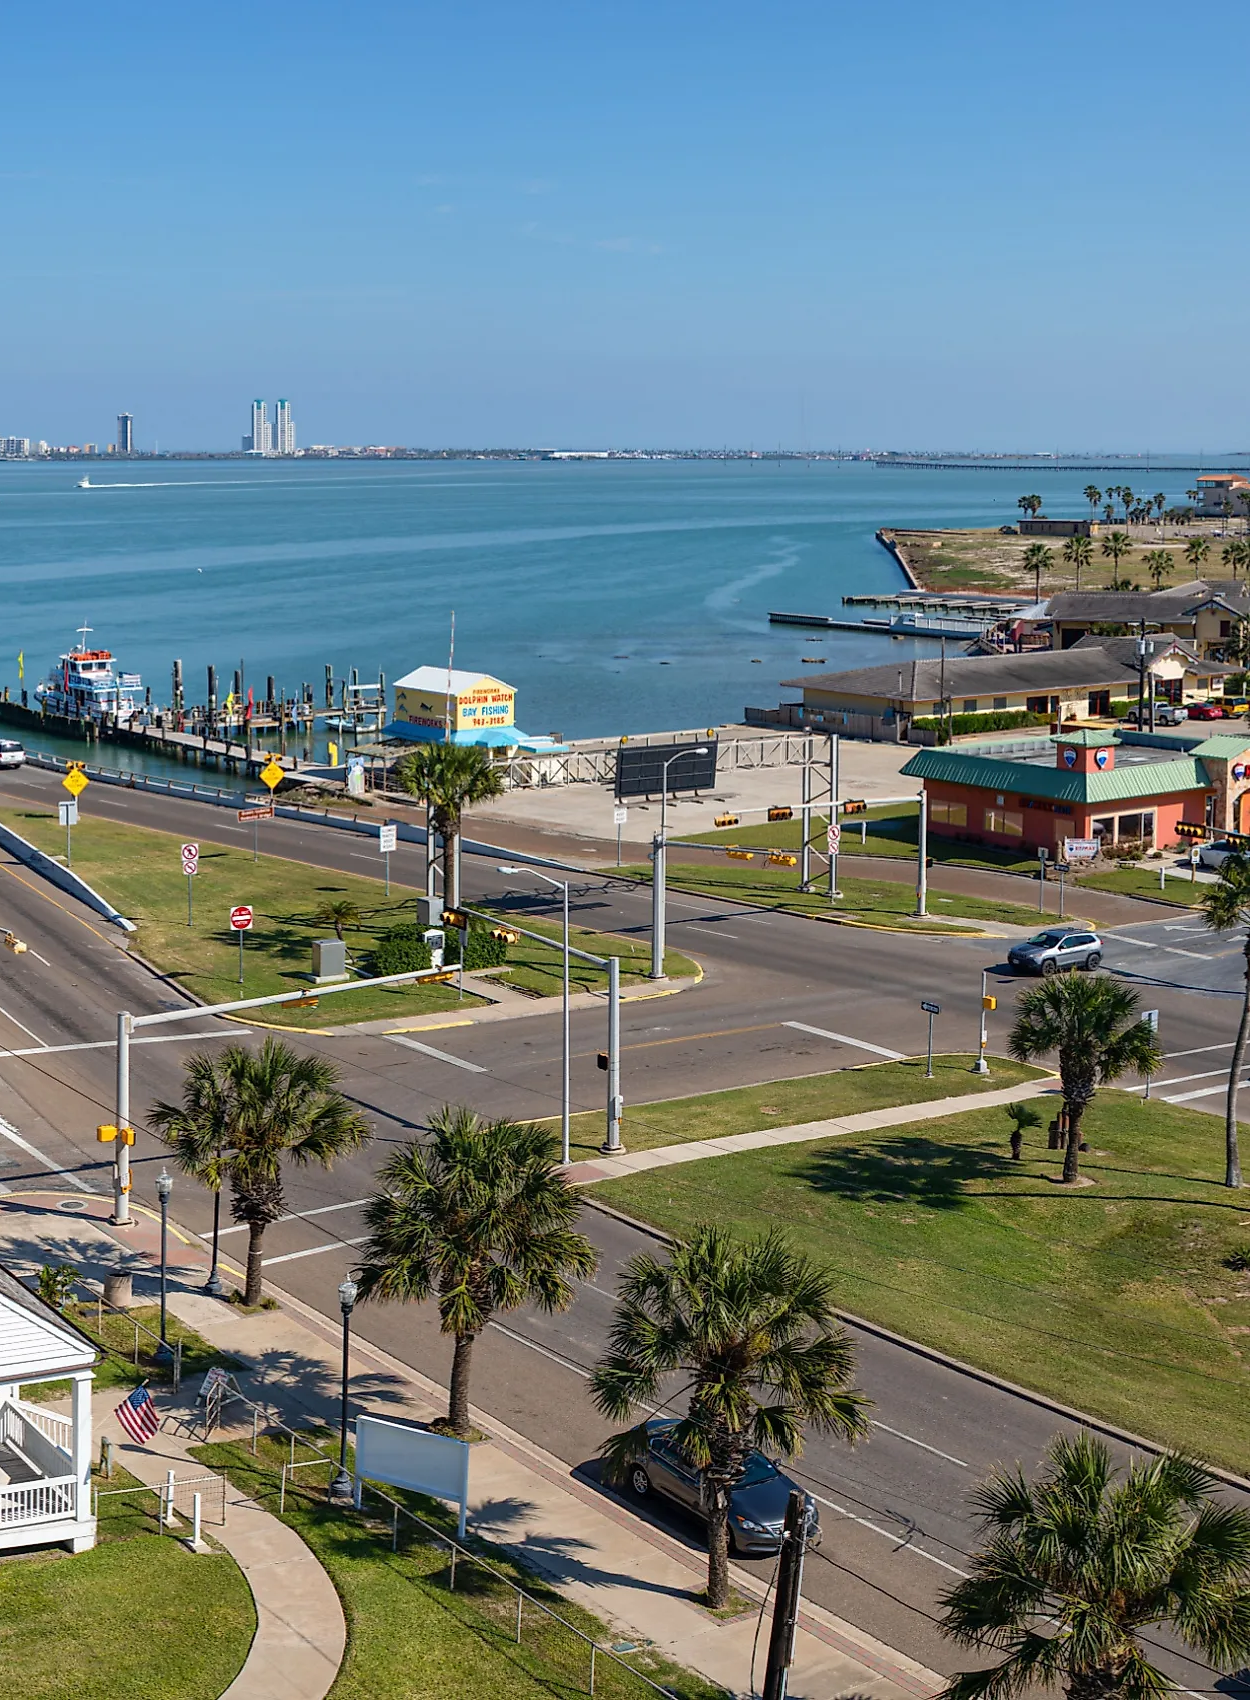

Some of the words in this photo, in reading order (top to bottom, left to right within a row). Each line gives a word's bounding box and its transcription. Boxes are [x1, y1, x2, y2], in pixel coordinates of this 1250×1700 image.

[458, 695, 488, 705] DOLPHIN
[491, 693, 513, 702] WATCH
[462, 707, 478, 717] BAY
[481, 704, 509, 715] FISHING
